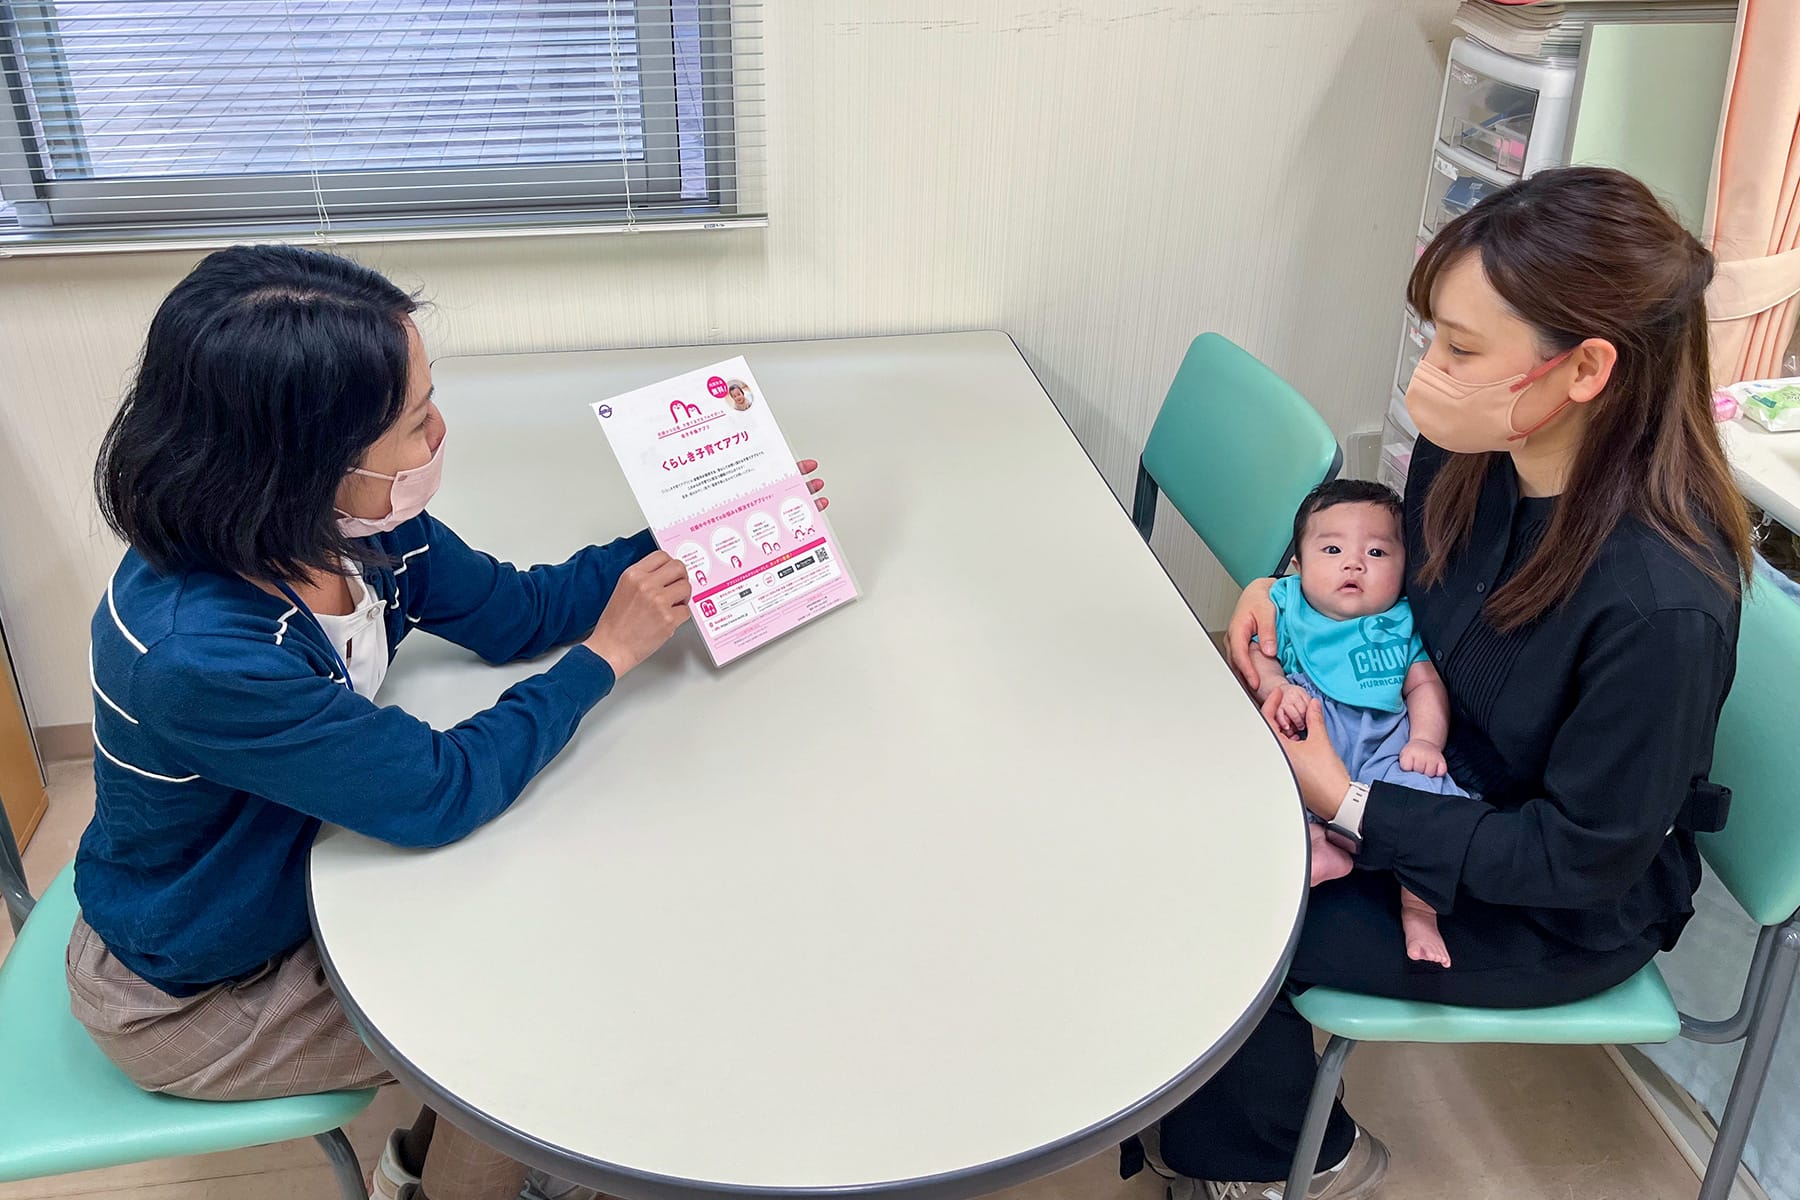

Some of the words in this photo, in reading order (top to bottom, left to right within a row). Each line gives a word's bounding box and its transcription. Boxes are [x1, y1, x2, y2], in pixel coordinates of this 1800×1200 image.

[662, 430, 749, 471] くらしき子育てアプリ
